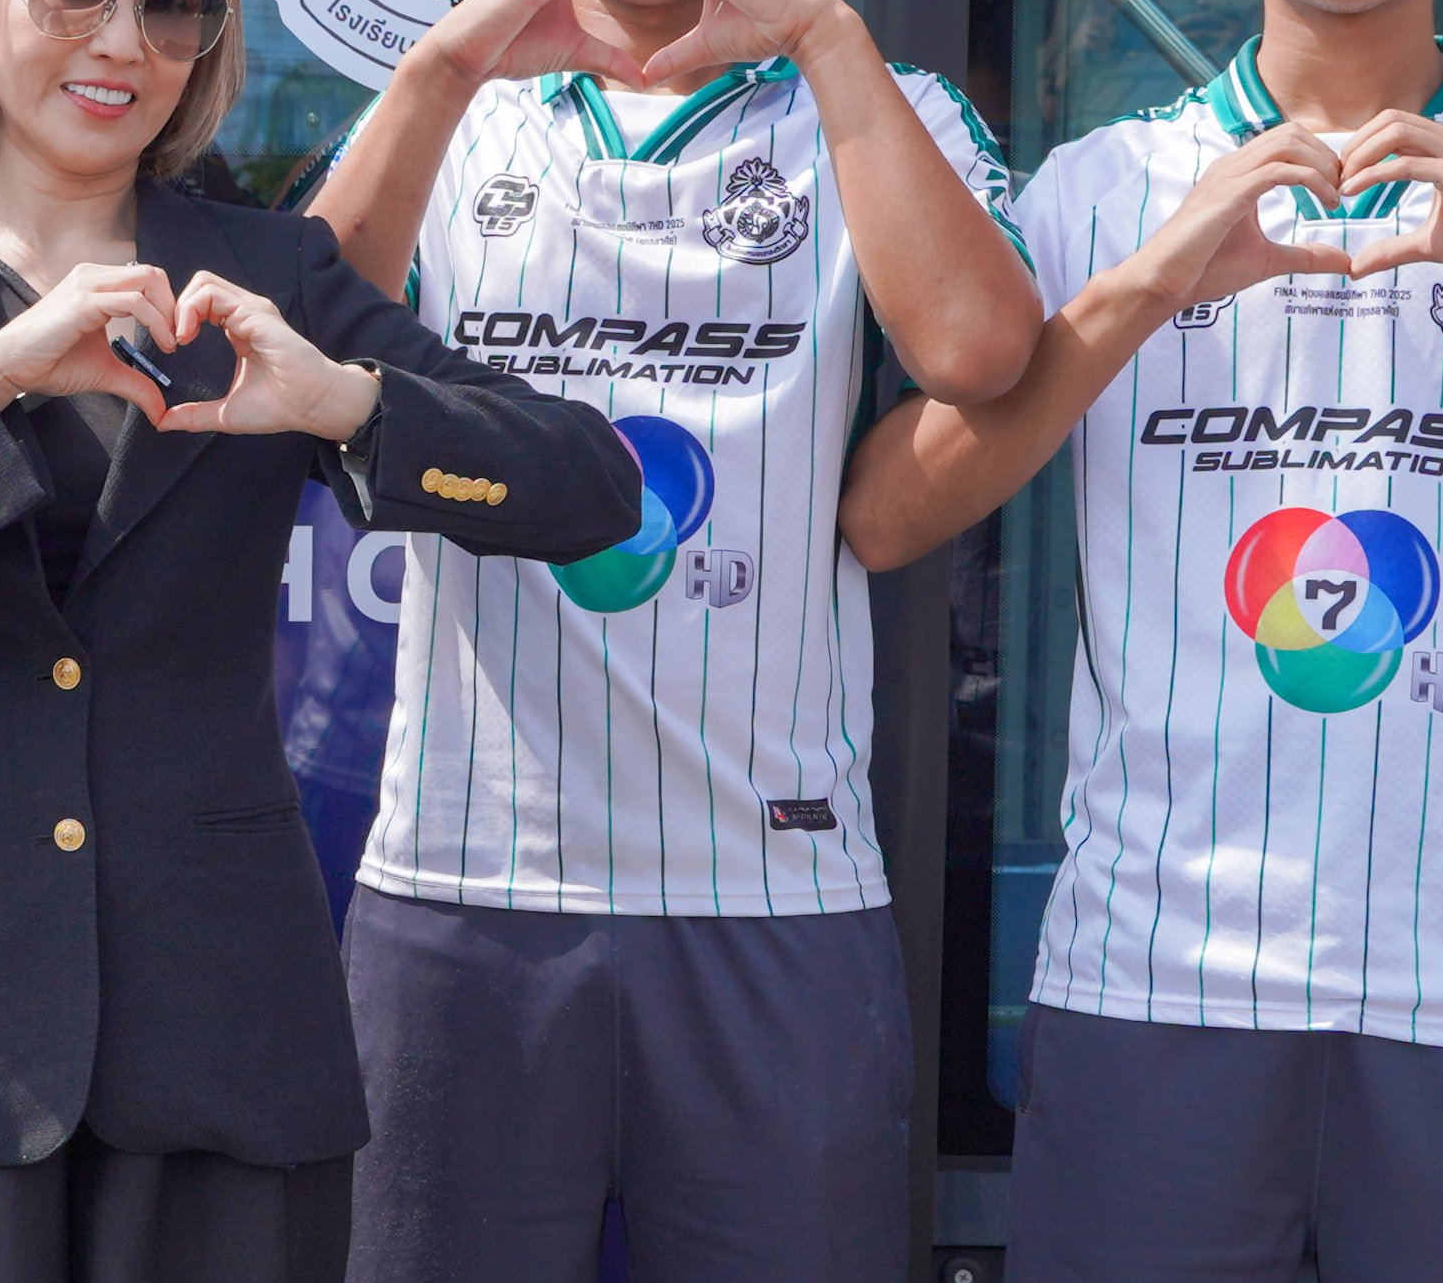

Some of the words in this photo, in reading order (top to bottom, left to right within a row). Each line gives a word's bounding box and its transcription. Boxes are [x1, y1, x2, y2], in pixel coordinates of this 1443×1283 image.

[1274, 286, 1297, 297] FINAL
[1370, 288, 1387, 299] 7HD
[1389, 289, 1412, 301] 2025
[453, 310, 808, 360] COMPASS
[485, 354, 757, 386] SUBLIMATION
[684, 547, 756, 610] HD
[1304, 577, 1358, 631] 7
